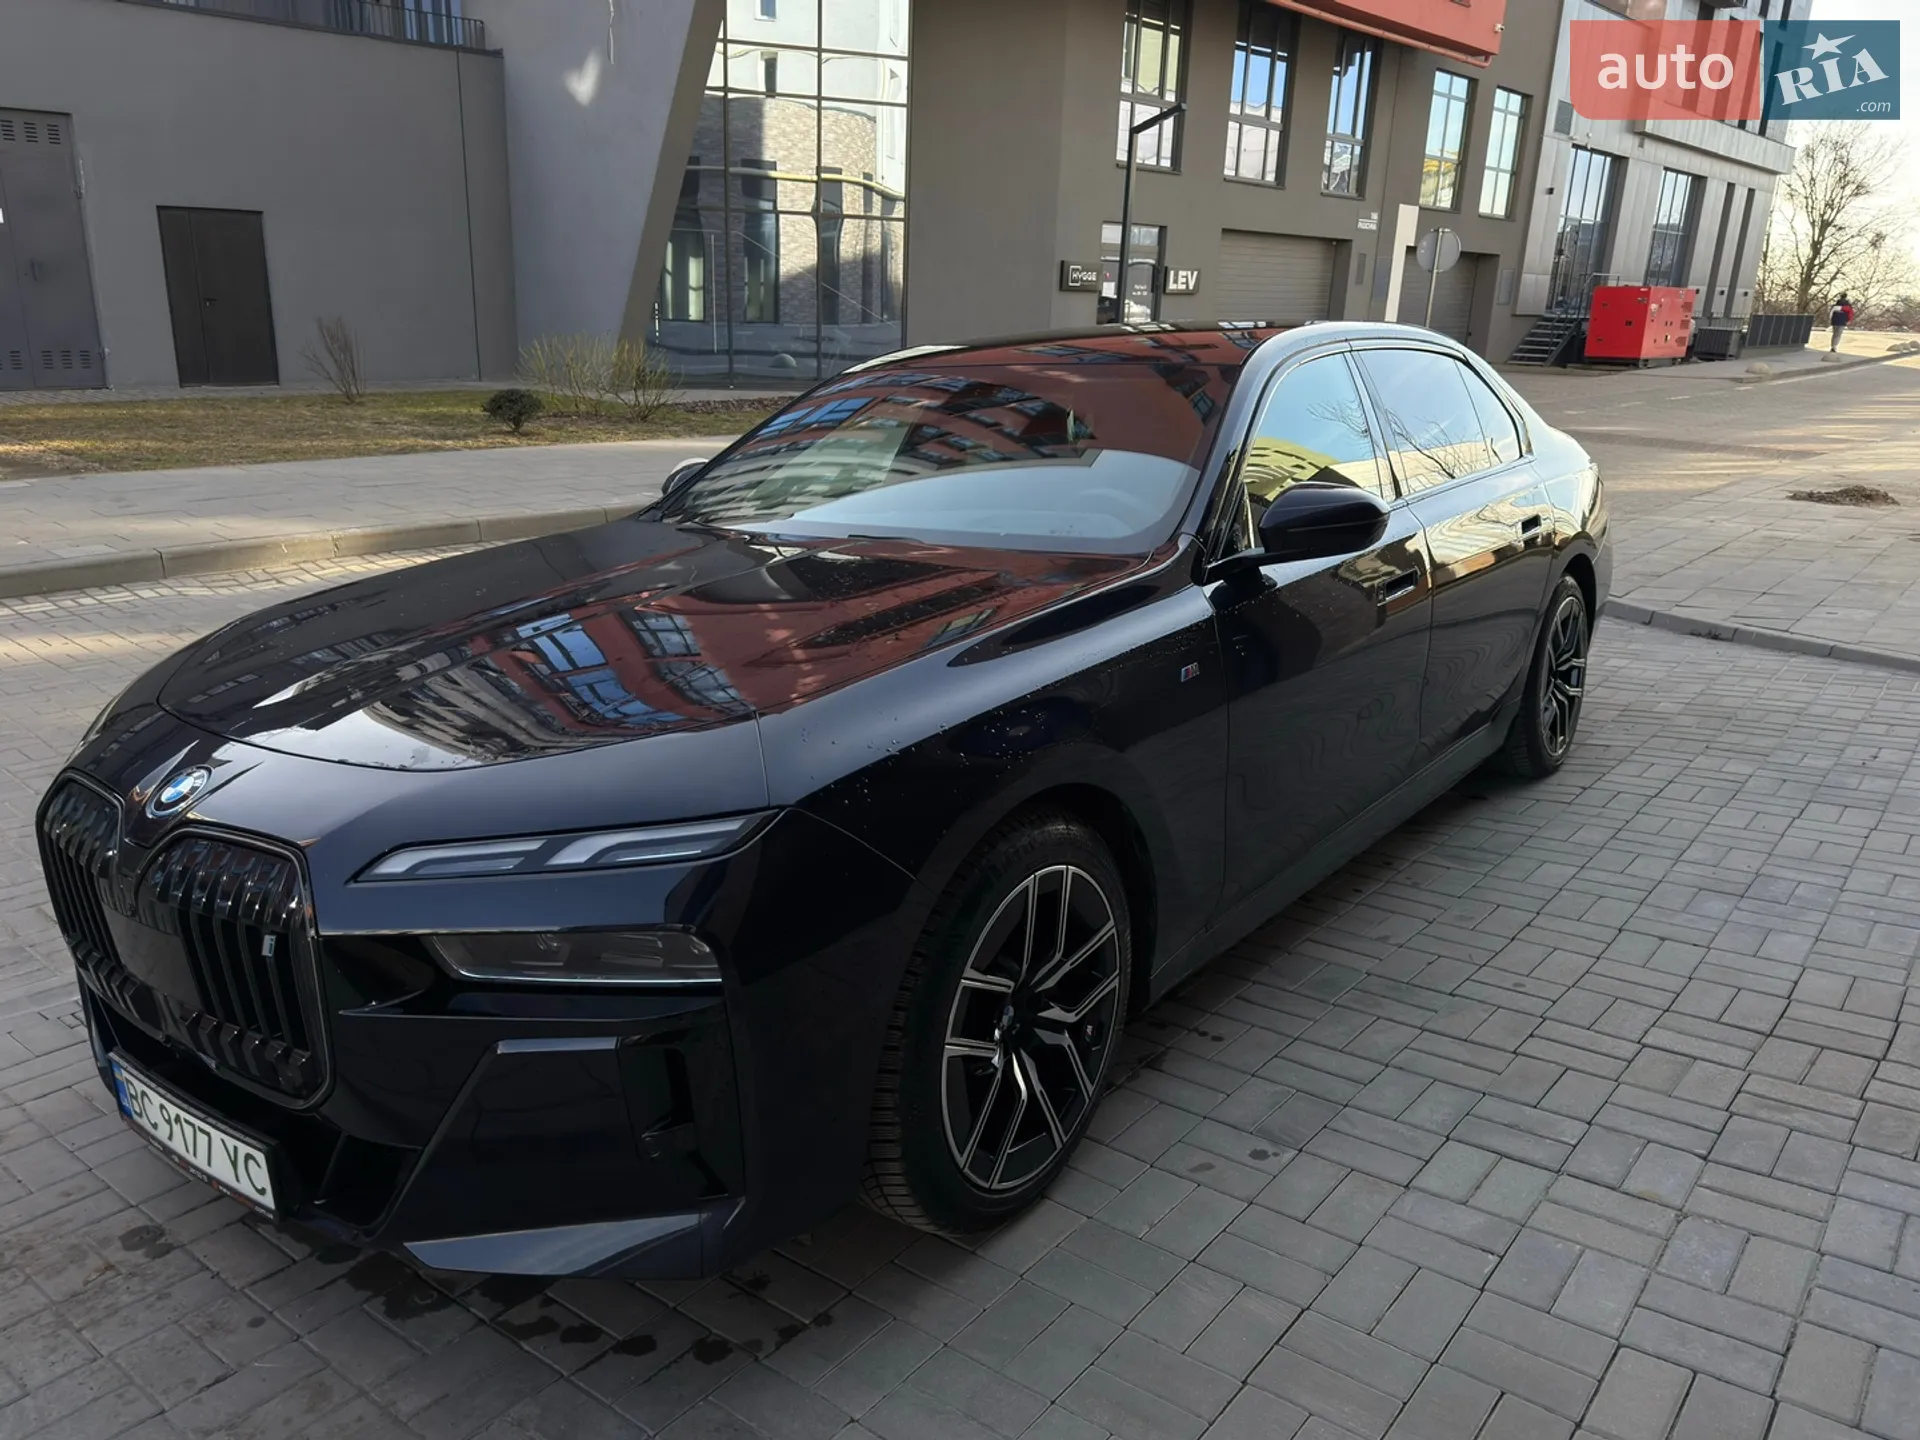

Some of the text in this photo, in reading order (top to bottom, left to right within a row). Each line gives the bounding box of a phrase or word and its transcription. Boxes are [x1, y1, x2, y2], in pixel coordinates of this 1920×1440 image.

[1072, 271, 1097, 281] HYGGE
[1169, 270, 1198, 290] LEV
[124, 1076, 158, 1131] BC
[159, 1102, 212, 1168] 9177
[220, 1138, 267, 1196] YC
